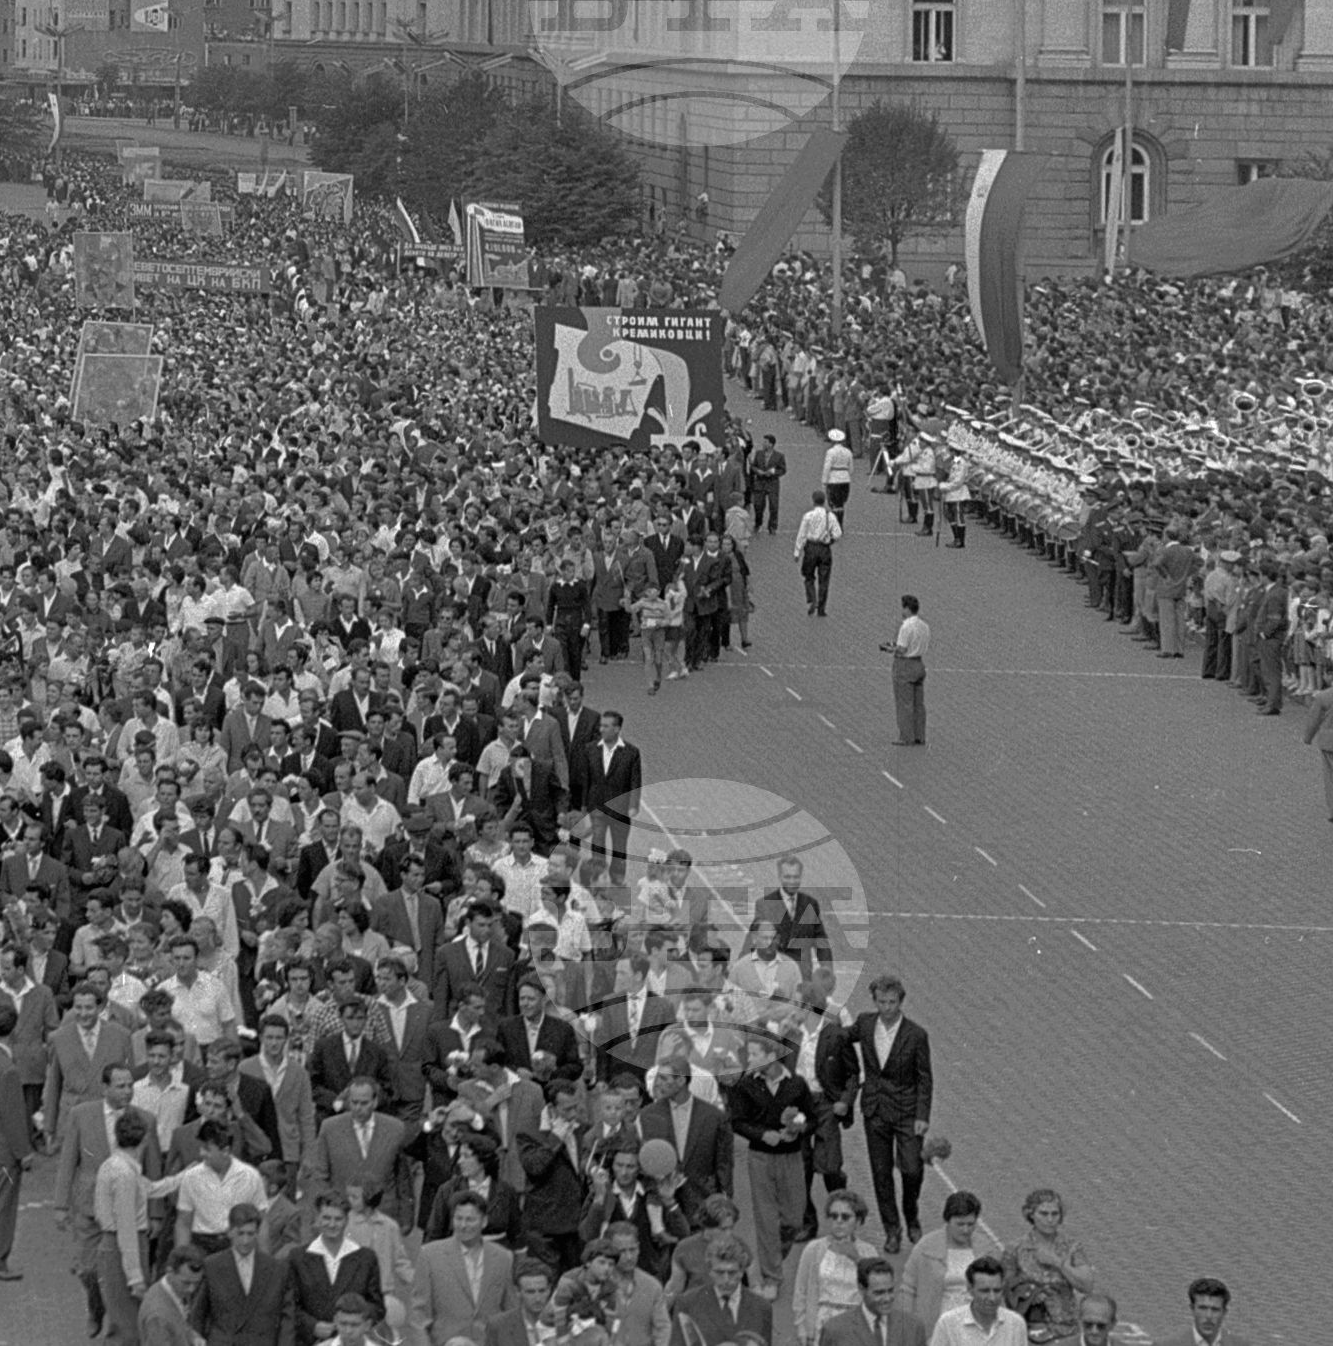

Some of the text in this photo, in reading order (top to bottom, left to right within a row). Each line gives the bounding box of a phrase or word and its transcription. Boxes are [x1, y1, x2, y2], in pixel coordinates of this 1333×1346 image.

[167, 274, 180, 285] НА
[187, 275, 206, 287] ЦК
[211, 277, 226, 288] НА
[232, 278, 261, 290] БКП
[606, 315, 712, 329] СТРОИМ ГИГАНТ
[613, 327, 711, 341] КРЕМИКОВЦИ!
